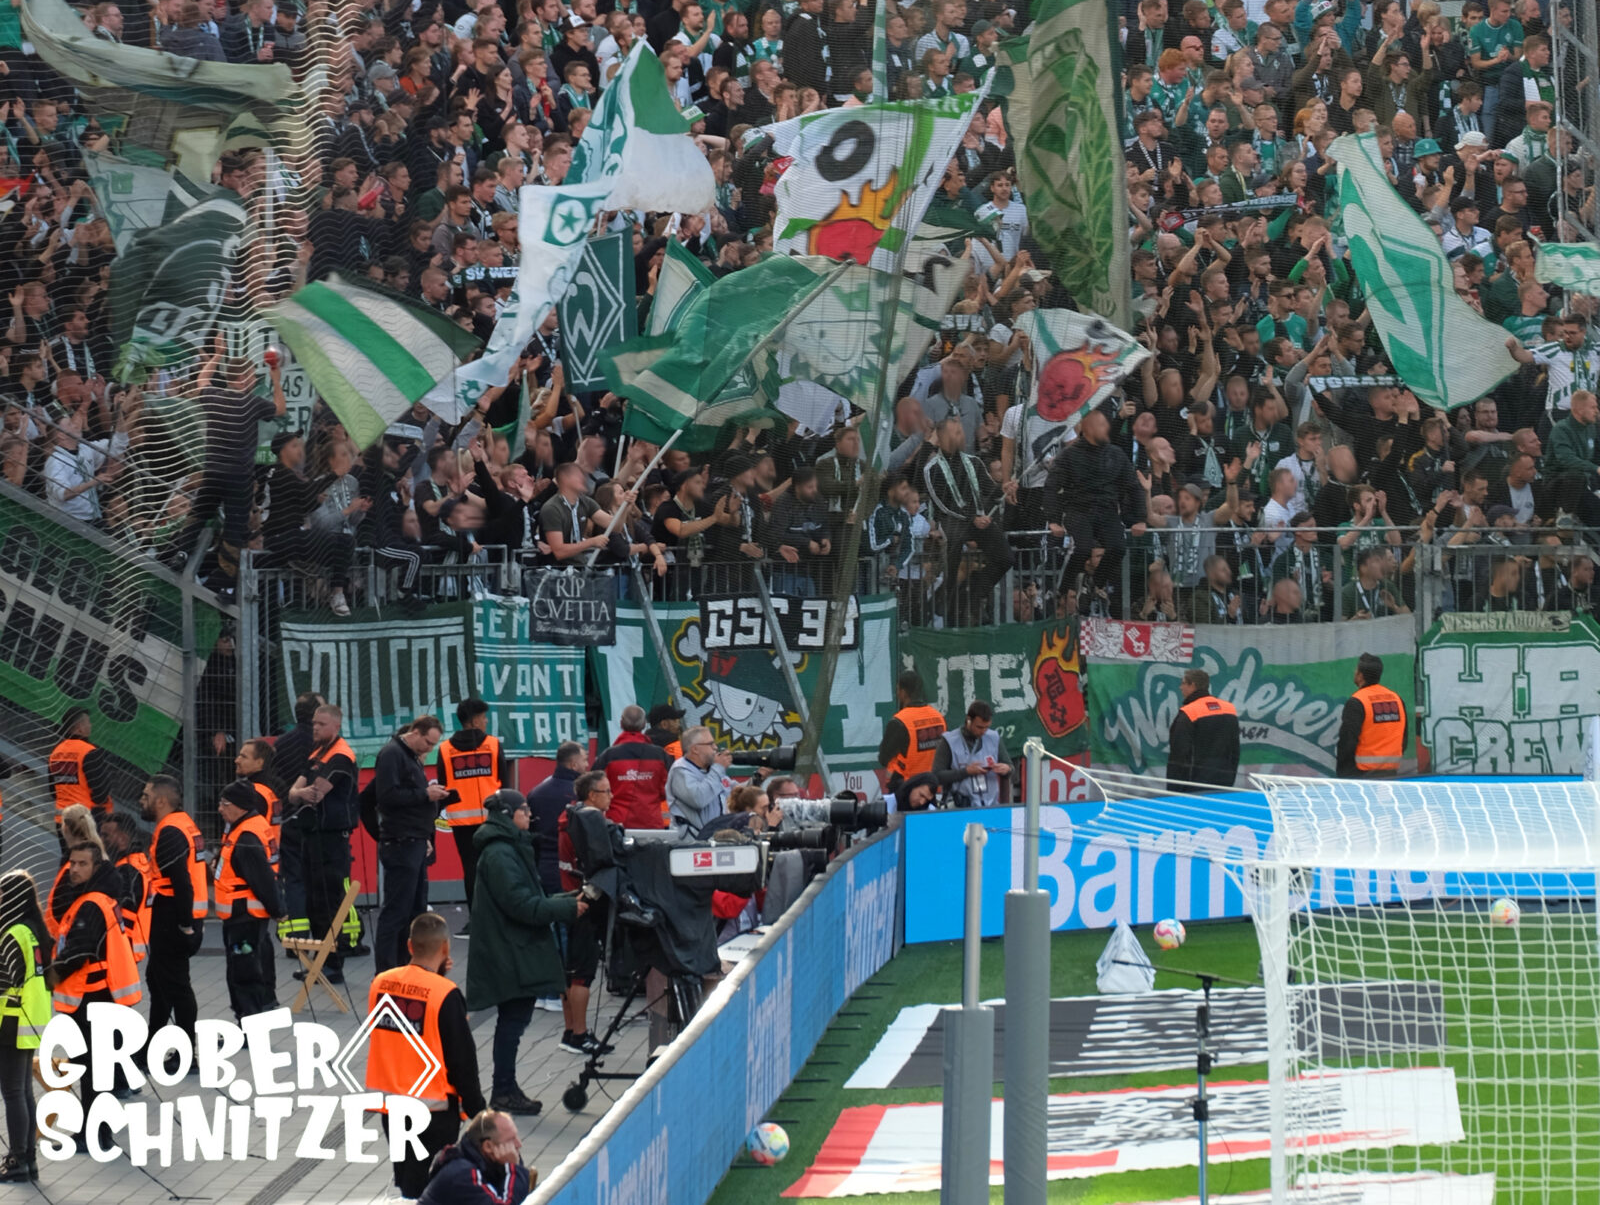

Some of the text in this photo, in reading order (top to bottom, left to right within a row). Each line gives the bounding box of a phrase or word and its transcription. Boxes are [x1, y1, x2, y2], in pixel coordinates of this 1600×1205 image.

[556, 577, 585, 598] RIP
[473, 606, 531, 639] SEM
[1441, 612, 1549, 632] WESERSTADION
[0, 589, 148, 723] MUS
[490, 711, 589, 744] LTRAS
[455, 768, 491, 778] SECURITAS
[844, 772, 863, 790] You
